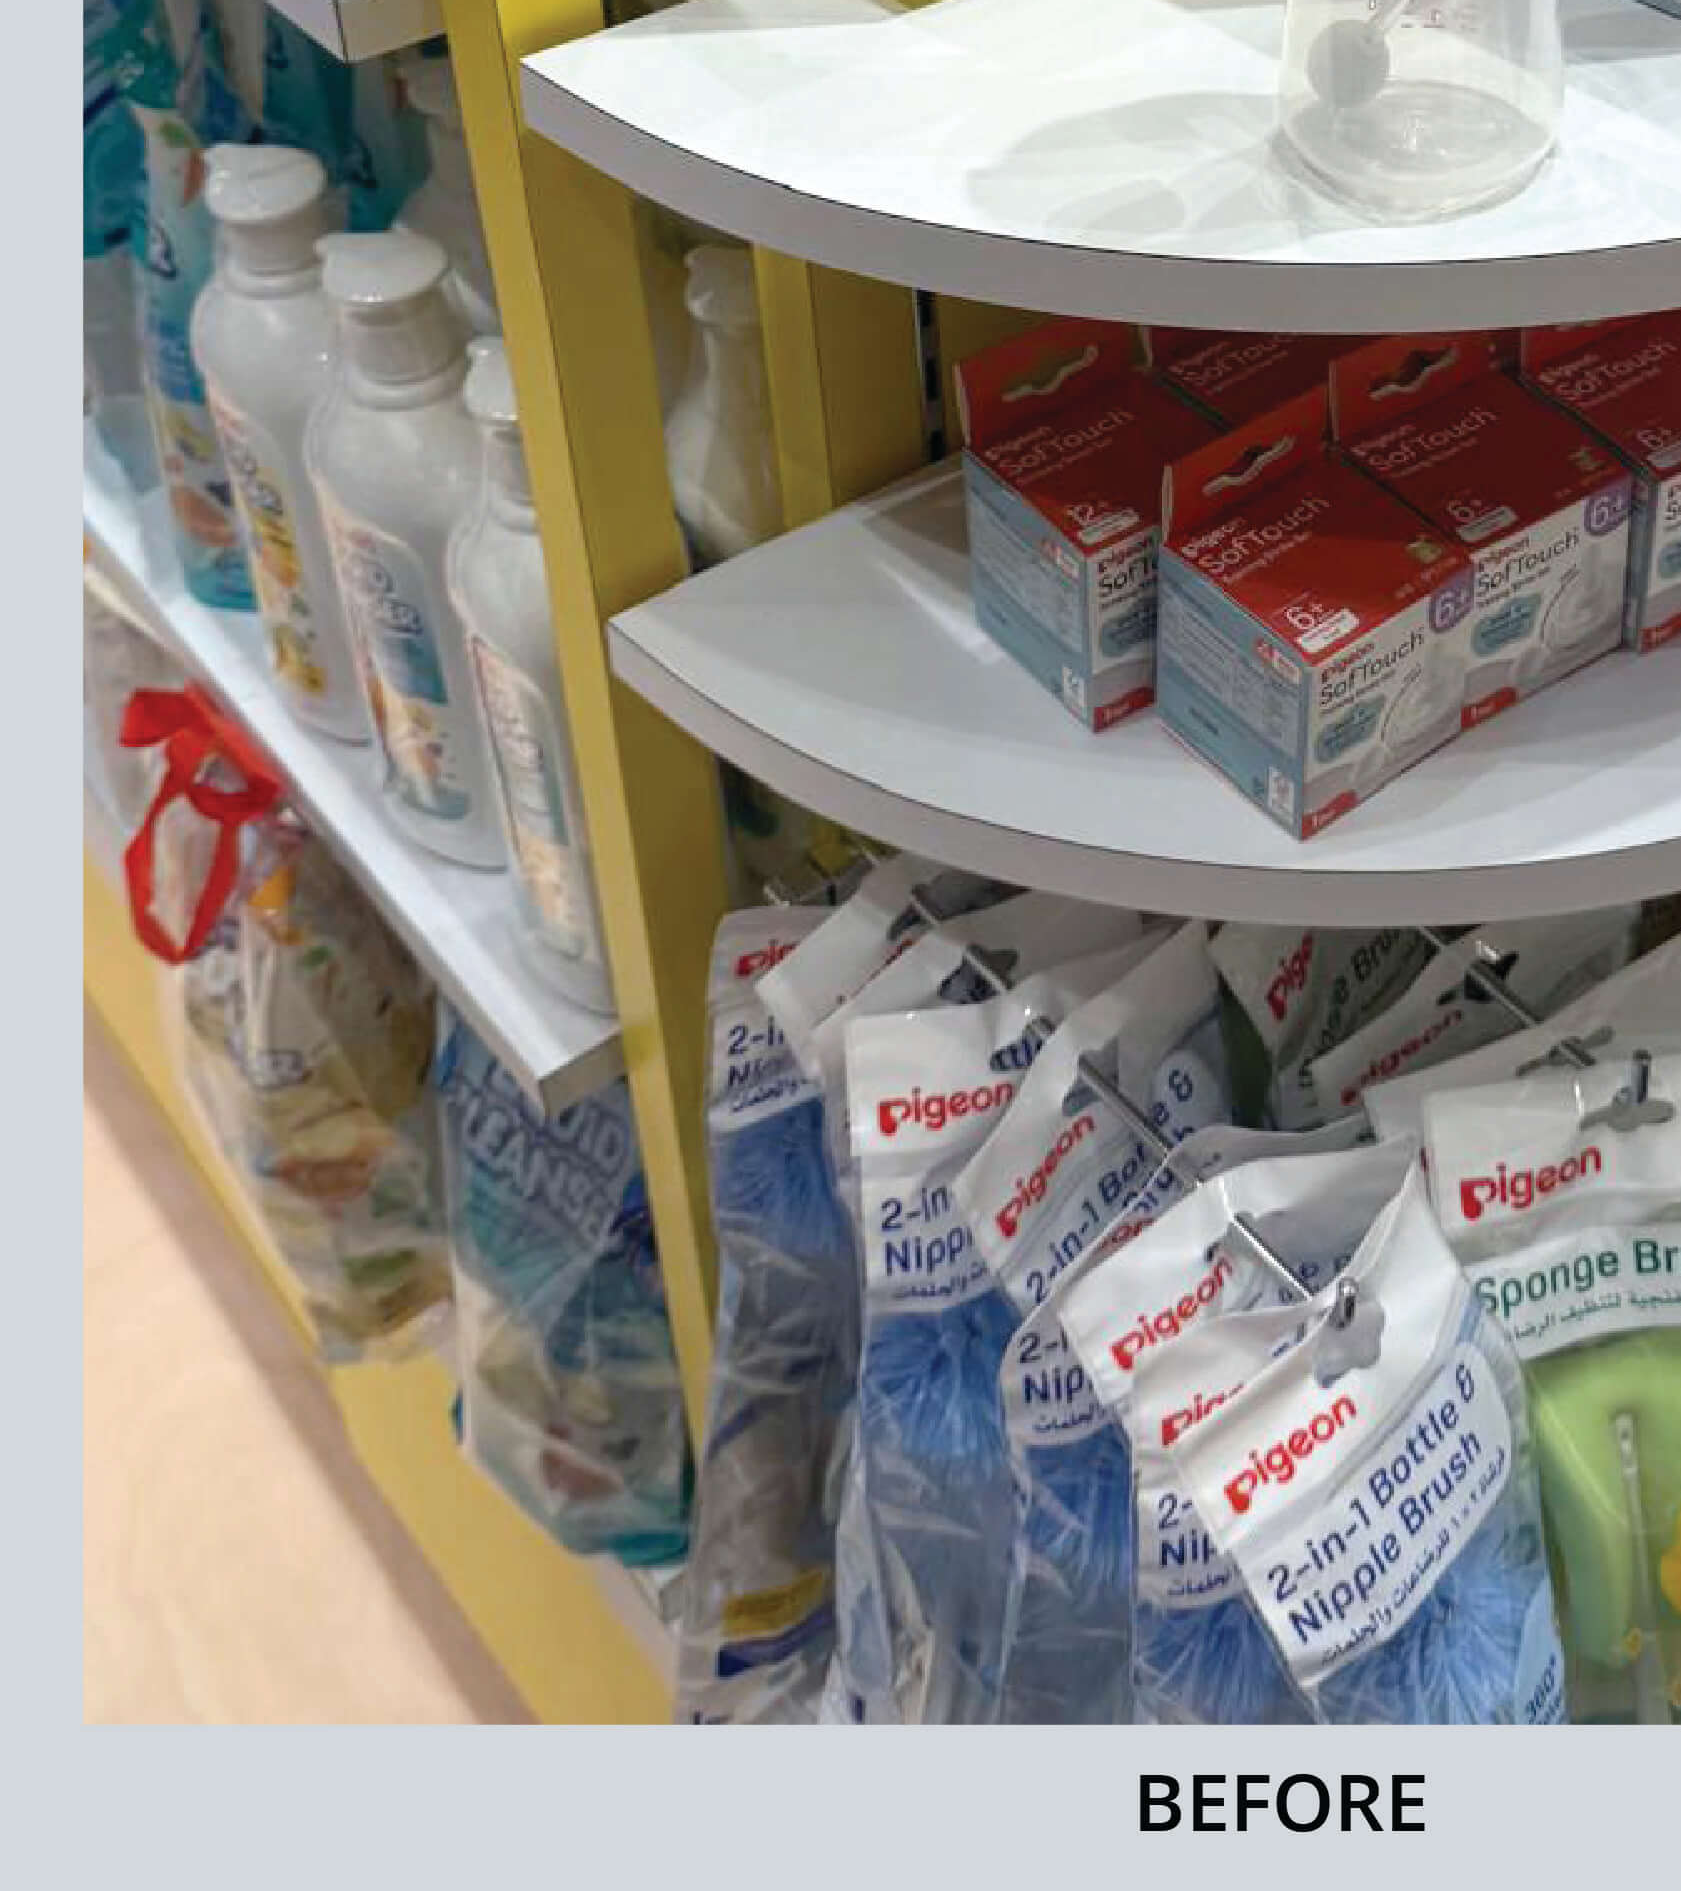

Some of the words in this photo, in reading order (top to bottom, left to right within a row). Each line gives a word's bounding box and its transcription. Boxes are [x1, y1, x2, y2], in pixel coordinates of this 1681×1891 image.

[1187, 336, 1298, 388] SofTou
[1559, 337, 1681, 405] SofTouch
[1368, 406, 1501, 473] SofTouch
[1200, 495, 1331, 576] SofTouch
[1589, 493, 1627, 526] 6+
[1098, 548, 1158, 596] SofT
[1476, 528, 1582, 594] SofTouch
[1433, 587, 1476, 624] 6+
[1320, 630, 1428, 707] SofTouch
[878, 1080, 1014, 1136] pigeon
[880, 1184, 949, 1232] 2-in
[996, 1109, 1097, 1239] pigeon
[1459, 1146, 1602, 1222] pigeon
[885, 1226, 975, 1277] Nipp
[1026, 1200, 1097, 1304] 2-in-1
[1099, 1143, 1148, 1212] Bot
[1108, 1256, 1234, 1372] pigeon
[1473, 1247, 1621, 1316] Sponge
[1022, 1364, 1092, 1406] Nip
[1223, 1392, 1358, 1515] pigeon
[1267, 1500, 1372, 1603] 2-in-1
[1368, 1398, 1461, 1506] Bottle
[1287, 1530, 1402, 1644] Nipple
[1397, 1430, 1483, 1536] Brush
